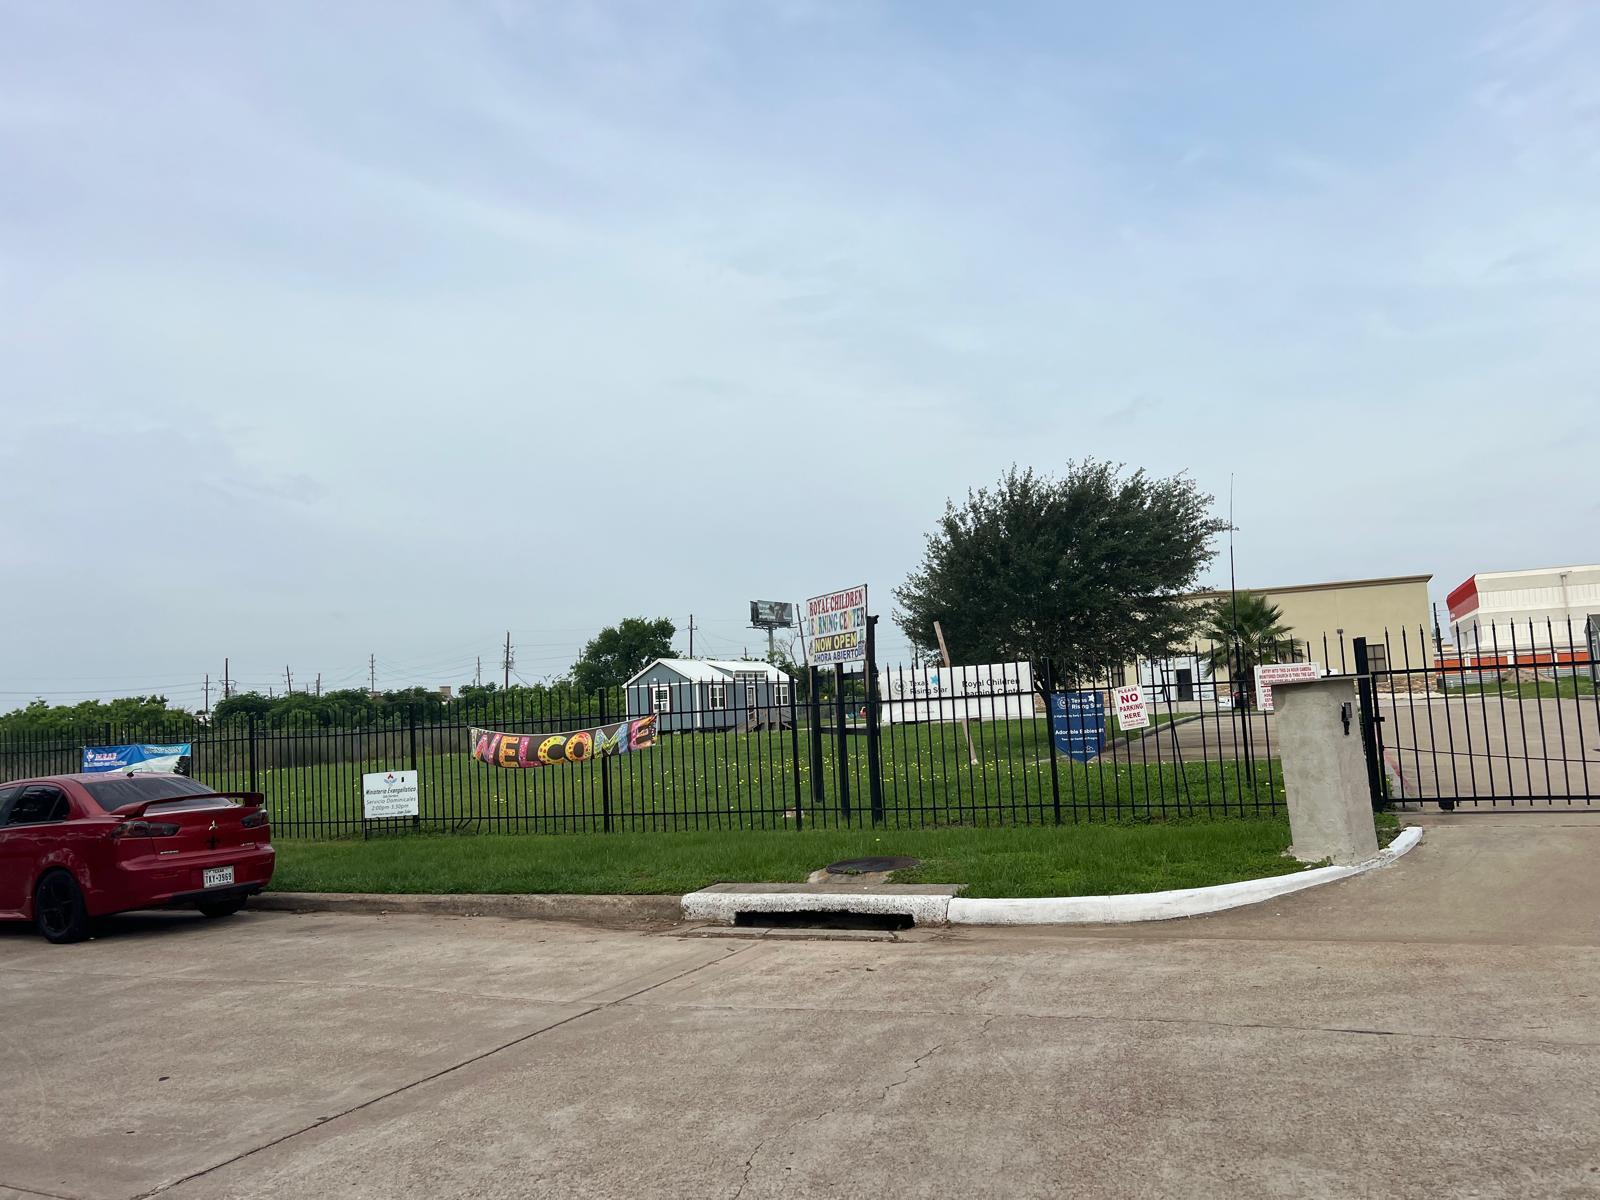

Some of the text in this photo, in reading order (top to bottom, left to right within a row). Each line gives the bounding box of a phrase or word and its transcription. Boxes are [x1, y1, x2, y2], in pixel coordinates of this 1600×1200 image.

[809, 588, 863, 616] ROYAL CHILDREN
[840, 606, 865, 630] CENTER
[815, 632, 857, 652] NOW OPEN
[814, 649, 859, 662] AHORA ABIERTO
[962, 679, 984, 689] Royal
[909, 687, 932, 695] Rsing
[1120, 693, 1138, 704] NO
[1119, 703, 1143, 713] PARKING
[1124, 711, 1141, 720] HERE
[472, 715, 656, 768] WELCOME
